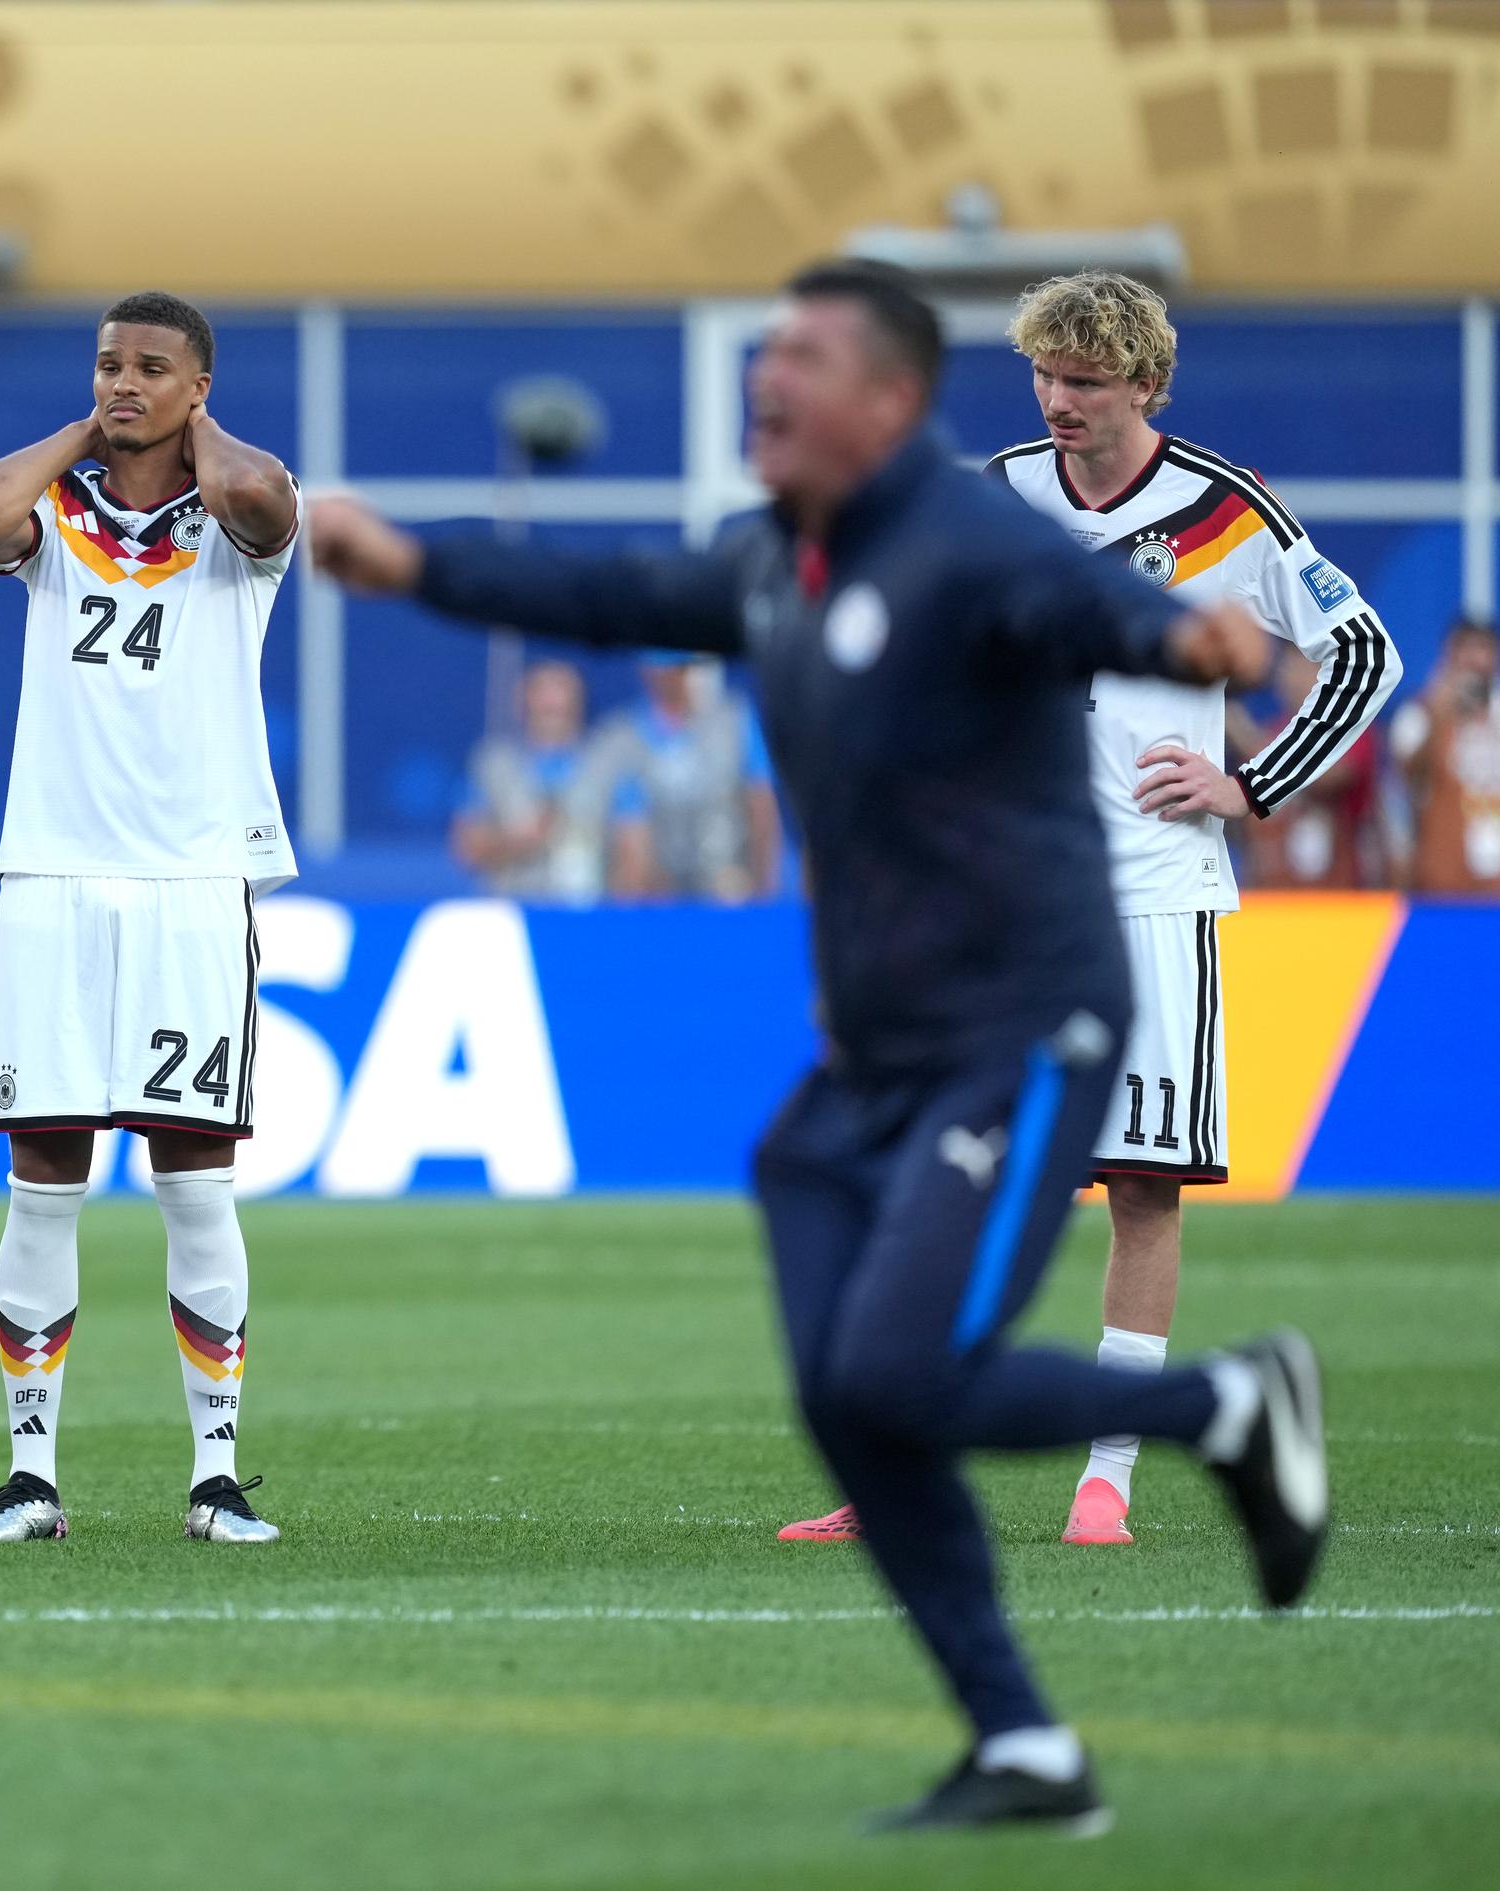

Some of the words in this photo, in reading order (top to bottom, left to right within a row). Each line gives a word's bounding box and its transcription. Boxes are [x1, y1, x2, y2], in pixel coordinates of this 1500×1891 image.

[72, 595, 164, 670] 24
[143, 1029, 229, 1107] 24
[1124, 1073, 1179, 1150] 11
[15, 1388, 48, 1404] DFB
[209, 1395, 237, 1409] DFB
